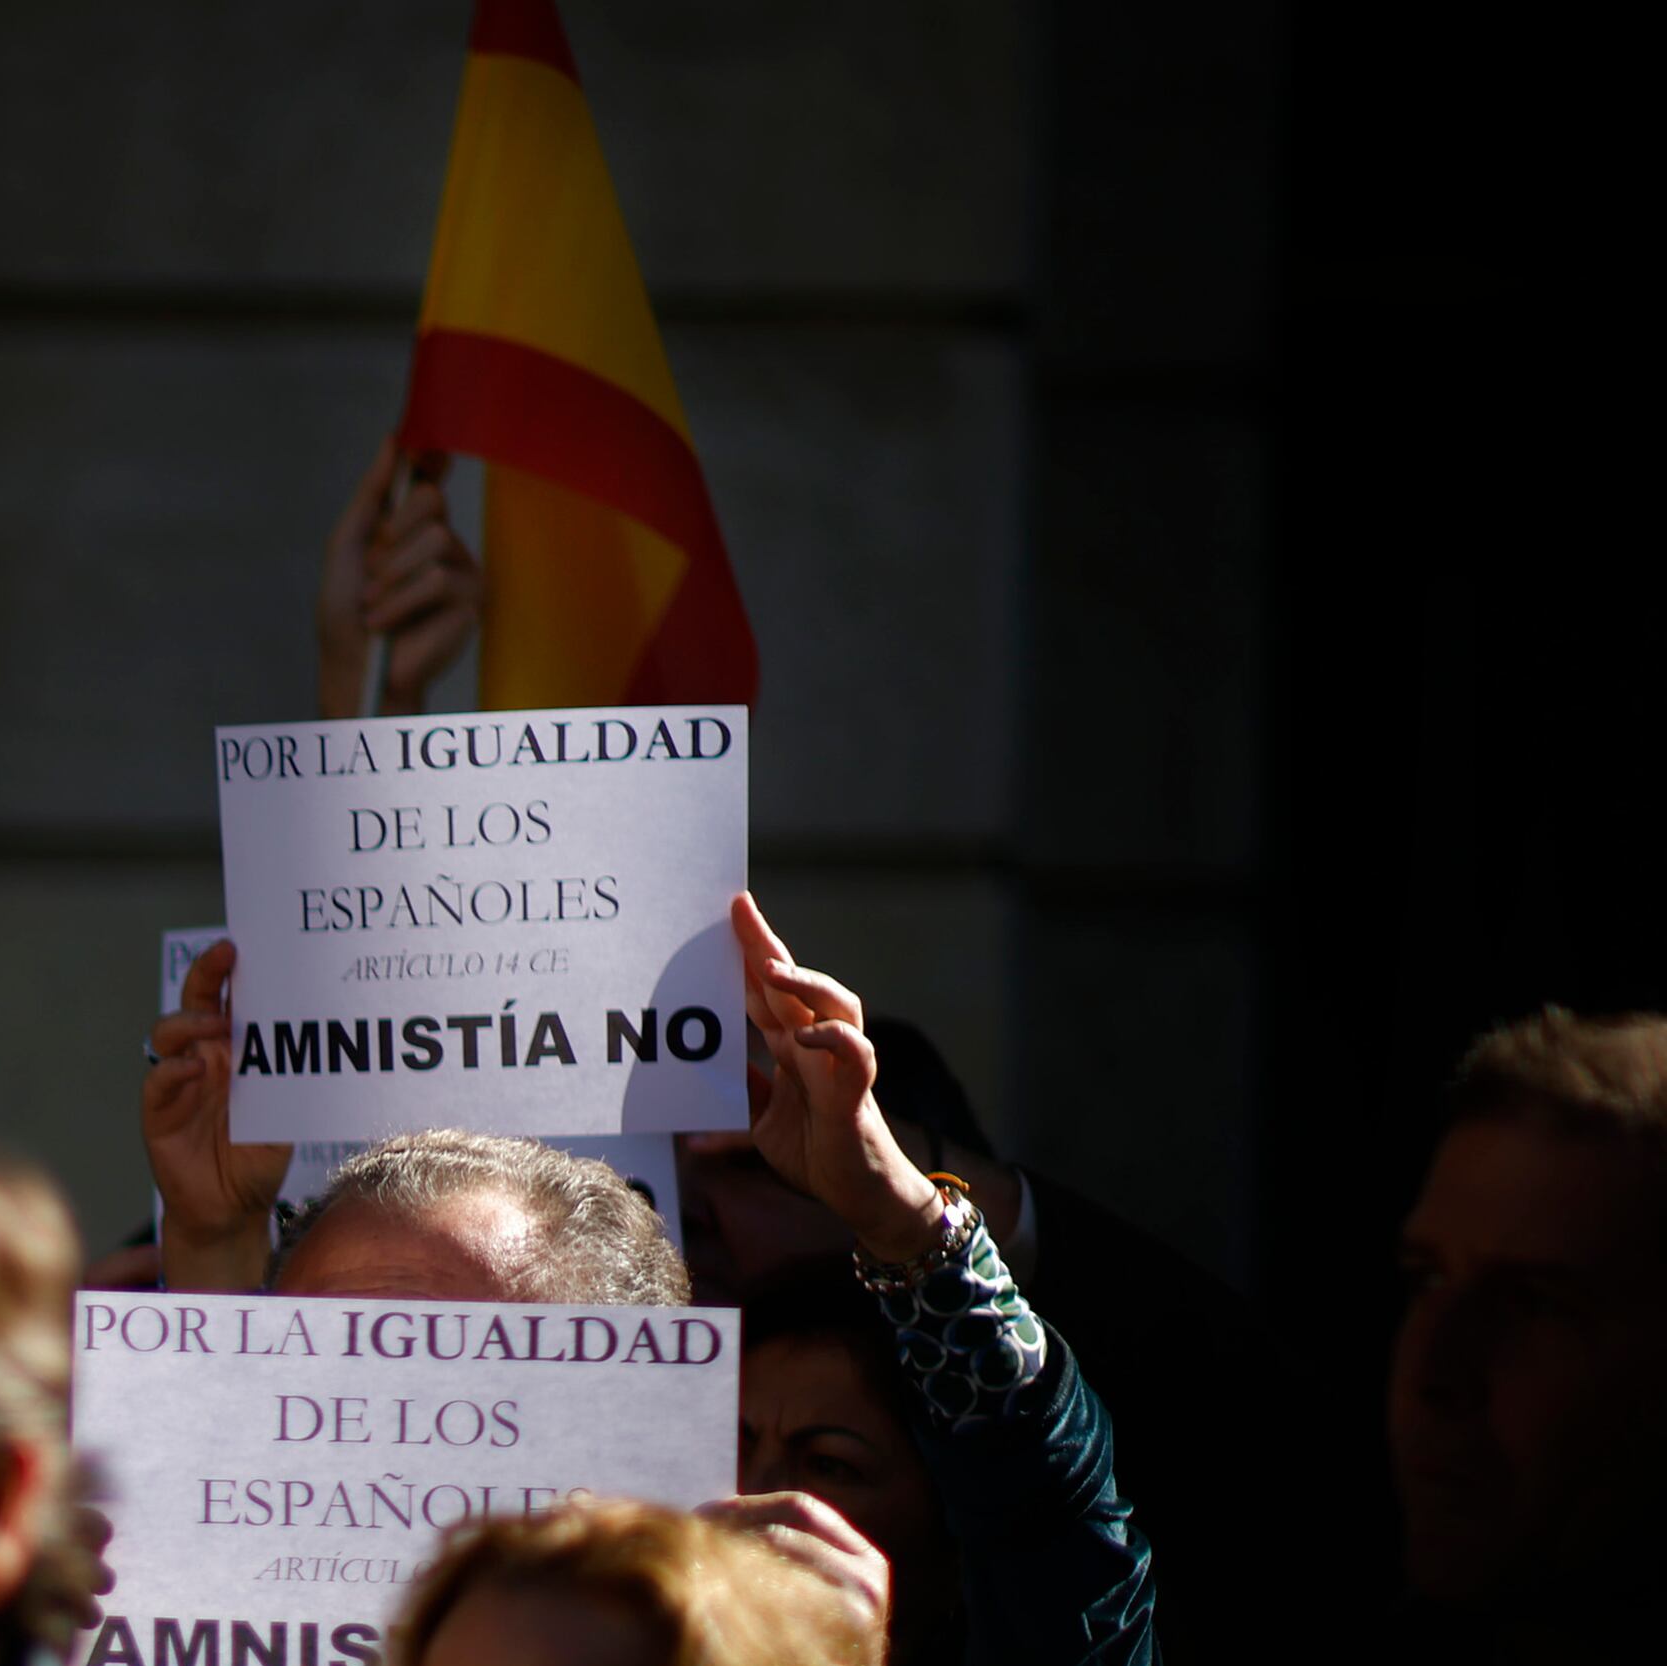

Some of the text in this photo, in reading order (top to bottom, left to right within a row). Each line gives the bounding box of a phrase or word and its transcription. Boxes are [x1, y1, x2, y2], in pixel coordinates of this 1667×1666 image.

[221, 716, 732, 782] POR LA IGUALDAD
[348, 800, 552, 854] DE LOS
[298, 873, 620, 933] ESPAÑOLES
[341, 947, 571, 983] ARTÍCULO 14 CE
[239, 1000, 723, 1077] AMNISTÍA NO
[83, 1303, 722, 1366] POR LA IGUALDAD
[274, 1394, 520, 1449] DE LOS
[197, 1473, 595, 1531] ESPAÑOLE
